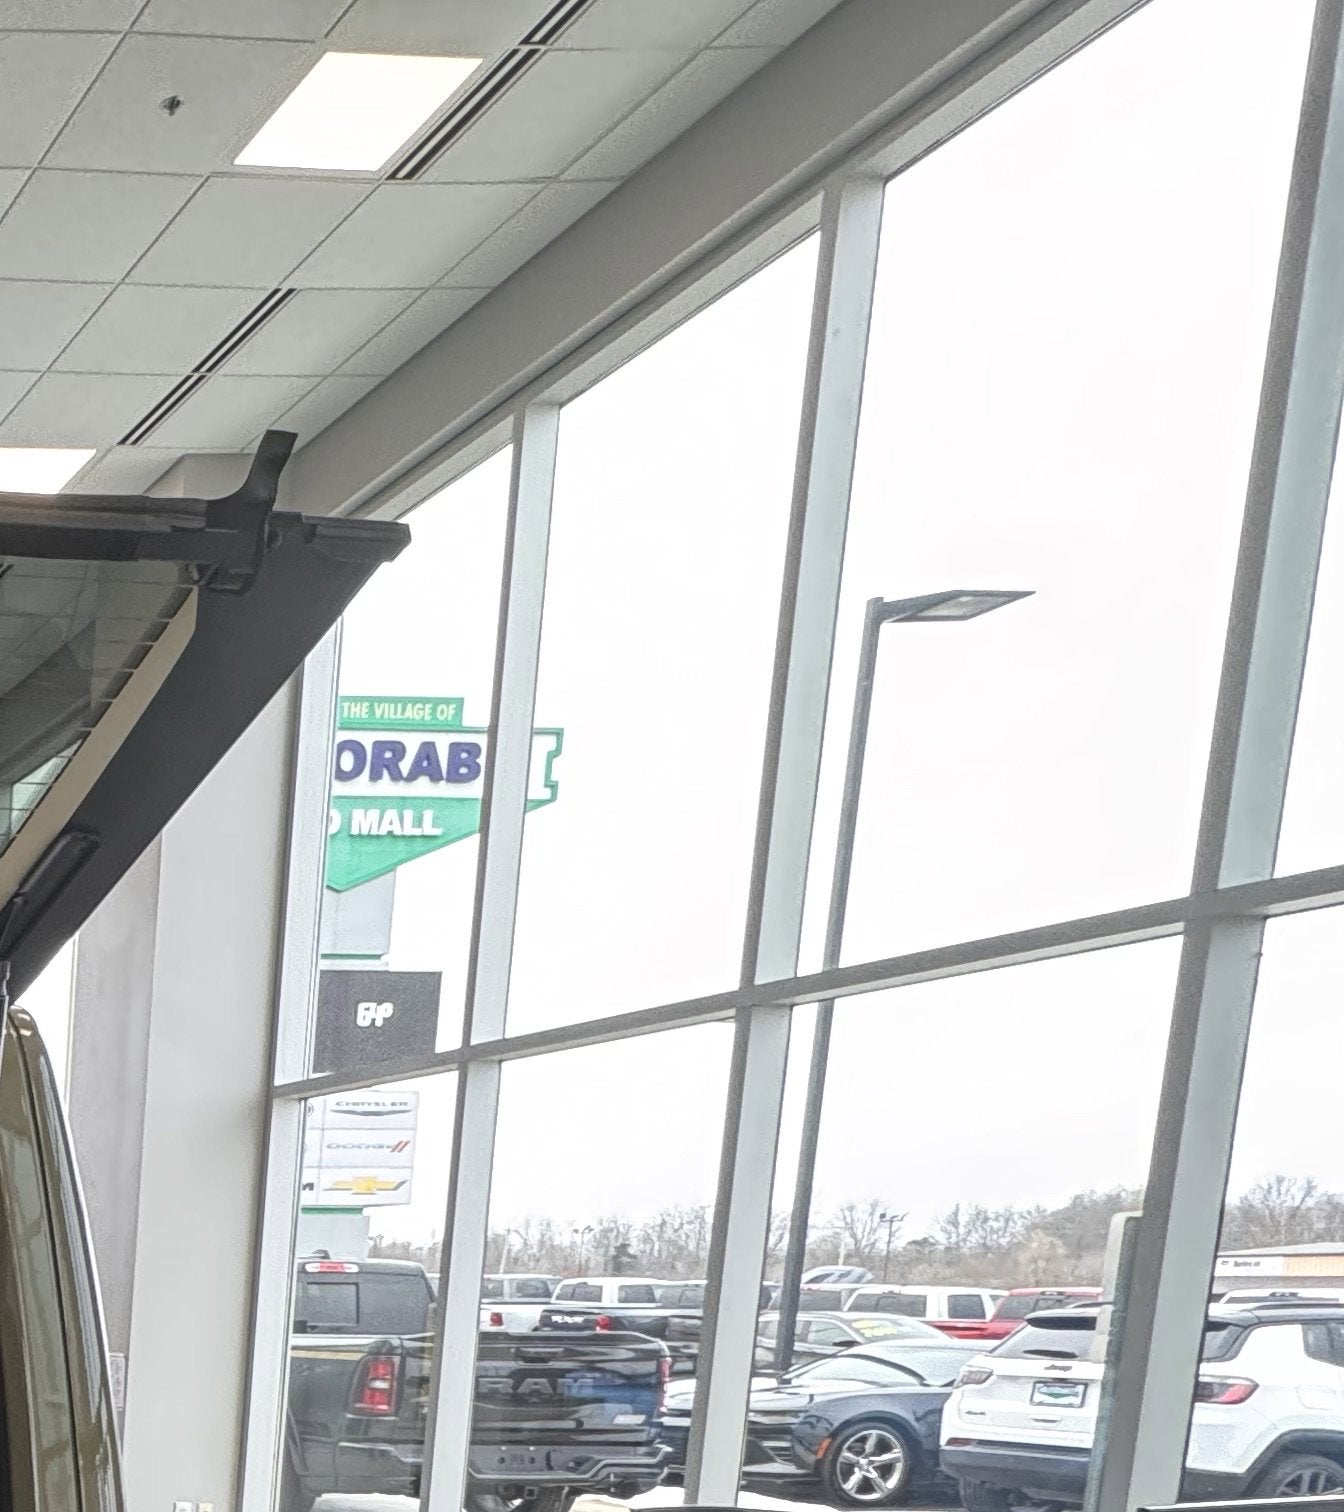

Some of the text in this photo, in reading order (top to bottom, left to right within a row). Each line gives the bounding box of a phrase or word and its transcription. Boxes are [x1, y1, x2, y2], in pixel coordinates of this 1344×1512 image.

[342, 702, 456, 721] THE VILLAGE OF
[334, 739, 482, 783] ORAB
[351, 808, 443, 836] MALL
[477, 1377, 595, 1395] RAM
